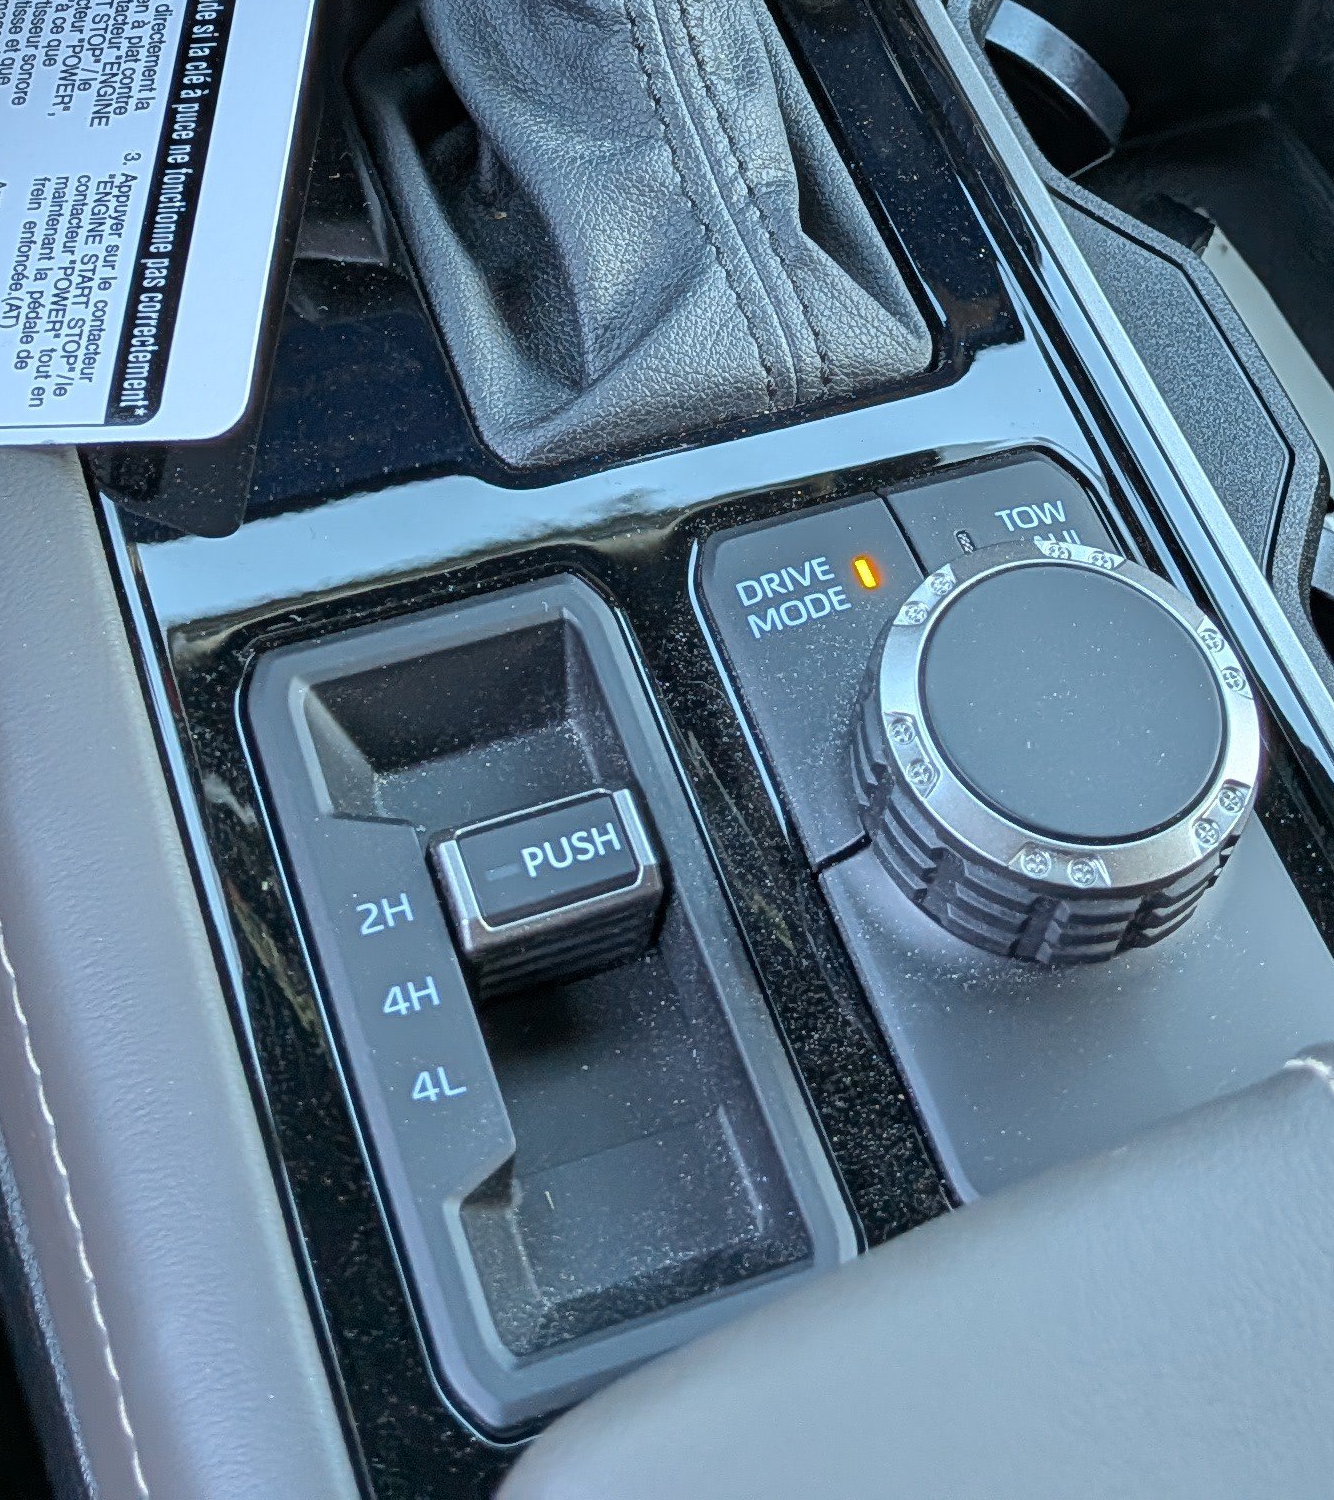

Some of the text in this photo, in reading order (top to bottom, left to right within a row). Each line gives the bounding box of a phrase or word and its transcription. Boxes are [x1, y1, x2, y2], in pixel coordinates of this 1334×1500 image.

[48, 15, 67, 35] ce
[129, 18, 150, 31] à
[190, 23, 220, 38] si
[2, 37, 22, 54] et
[40, 37, 62, 67] que
[122, 34, 145, 65] plat
[136, 2, 173, 94] directement
[186, 41, 218, 57] la
[10, 52, 37, 106] sonore
[47, 36, 86, 117] "POWER",
[181, 60, 213, 84] clé
[111, 66, 137, 116] contre
[132, 95, 156, 112] la
[179, 87, 209, 99] à
[170, 101, 200, 140] puce
[165, 143, 192, 164] ne
[60, 173, 92, 256] contacteur
[148, 166, 193, 253] fonctionne
[12, 175, 70, 370] maintenant la pédale de
[78, 151, 142, 383] 3. Appuyer sur le contacteur
[139, 256, 170, 288] pas
[32, 346, 58, 380] tout
[27, 385, 46, 408] en
[994, 500, 1066, 532] TOW
[735, 556, 835, 607] DRIVE
[747, 585, 852, 639] MODE
[521, 822, 622, 878] PUSH
[355, 892, 415, 936] 2H
[382, 975, 441, 1016] 4H
[411, 1066, 467, 1102] 4L
